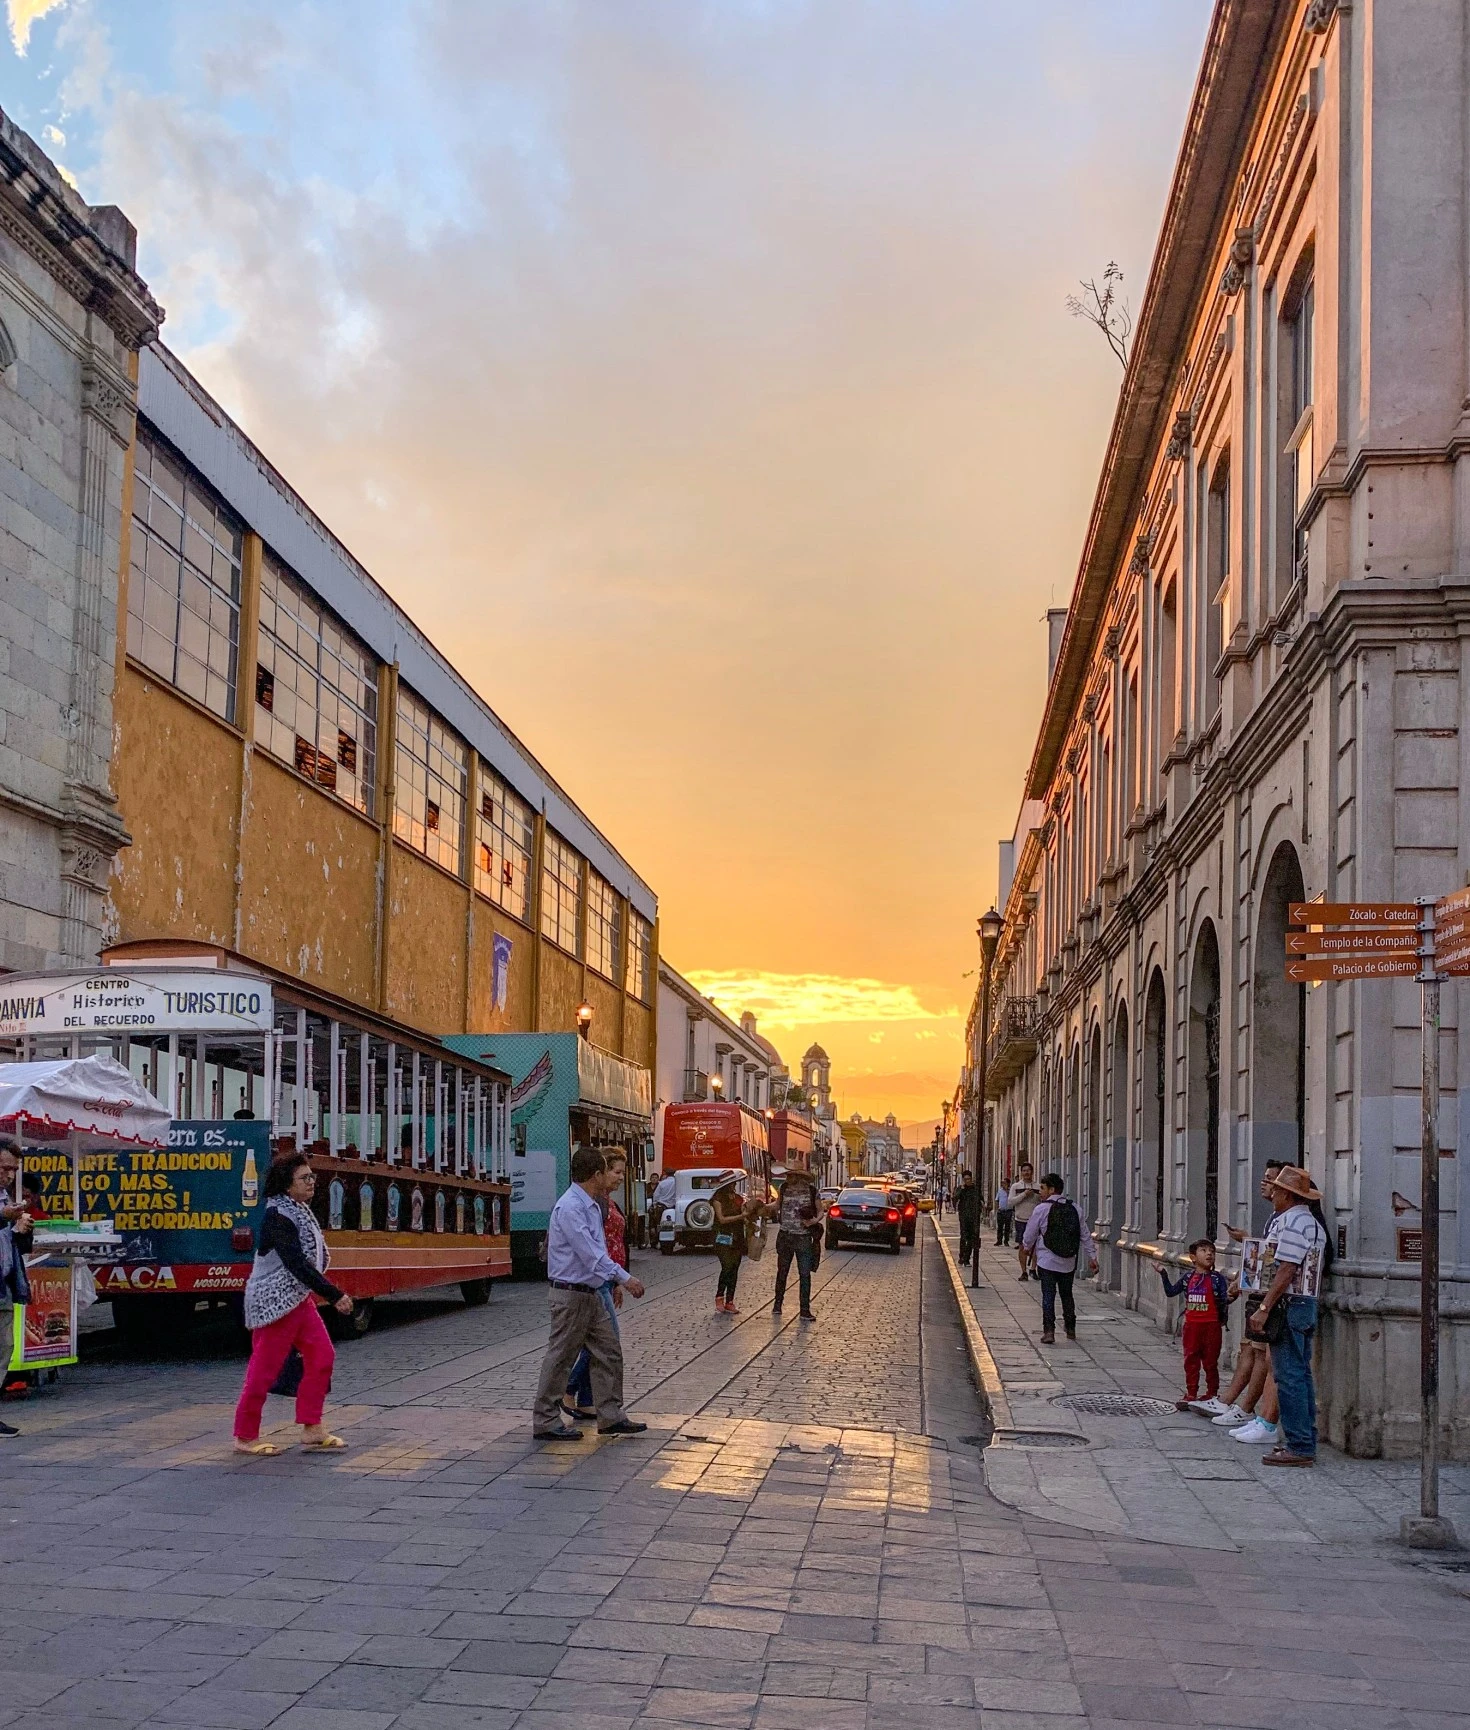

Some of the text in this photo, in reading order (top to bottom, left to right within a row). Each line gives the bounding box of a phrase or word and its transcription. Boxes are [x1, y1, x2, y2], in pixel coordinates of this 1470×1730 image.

[1349, 908, 1377, 920] Zócalo
[1384, 908, 1418, 920] Catedral
[1320, 934, 1418, 950] Templo de la Compañía
[1332, 960, 1417, 975] Palacio de Gobierno
[86, 980, 130, 990] CENTRO
[0, 991, 261, 1021] ANVIA Historico TURISTICO
[64, 1014, 155, 1027] DEL RECUERDO
[129, 1153, 232, 1171] TRADICION
[41, 1175, 54, 1192] Y
[120, 1173, 174, 1191] MAS.
[85, 1193, 99, 1211] Y
[208, 1266, 231, 1276] CON
[193, 1277, 245, 1288] NOSOTROS
